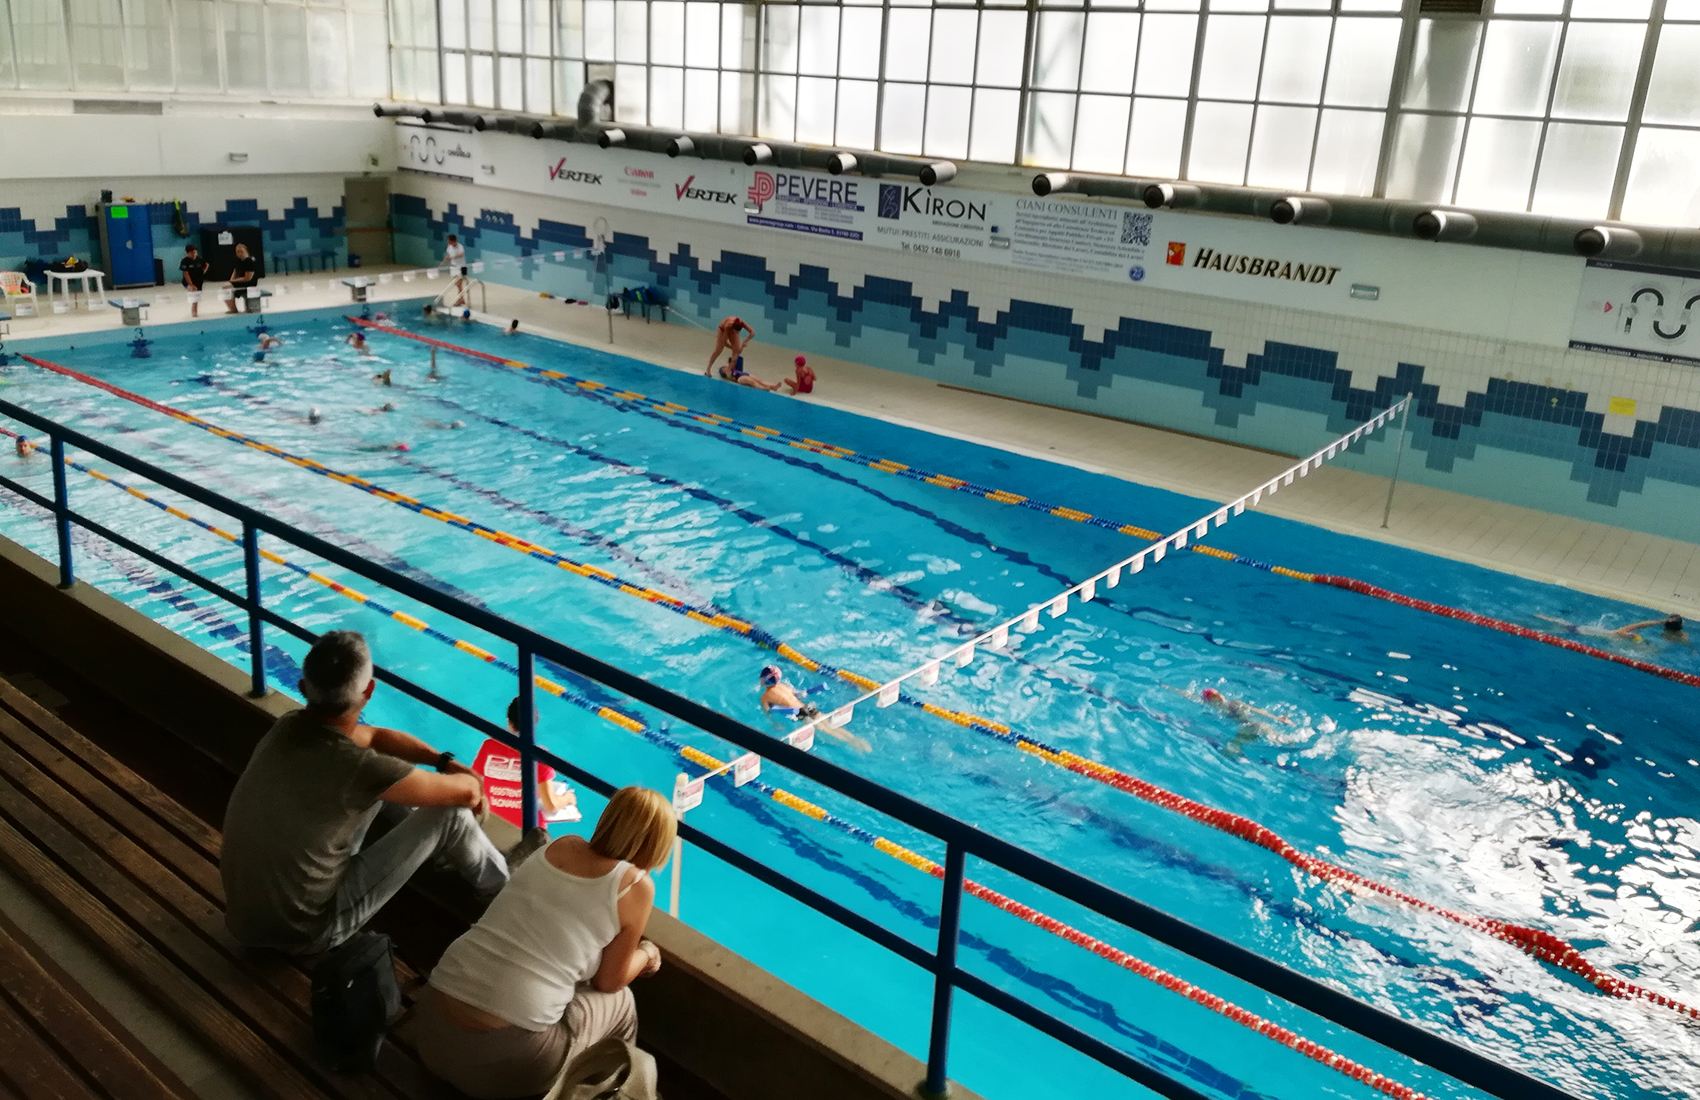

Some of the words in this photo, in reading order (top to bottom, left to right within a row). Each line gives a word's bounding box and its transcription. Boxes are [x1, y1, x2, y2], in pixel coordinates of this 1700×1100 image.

[548, 157, 603, 185] VERTEK
[675, 175, 738, 205] VERTEK
[776, 173, 858, 204] PEVERE
[1016, 199, 1046, 212] CIANI
[1048, 203, 1118, 220] CONSULENTI
[877, 226, 900, 236] MUTUI
[901, 229, 930, 240] PRESTITI
[932, 233, 984, 248] ASSICURAZIONI
[1192, 247, 1342, 285] HAUSBRANDT
